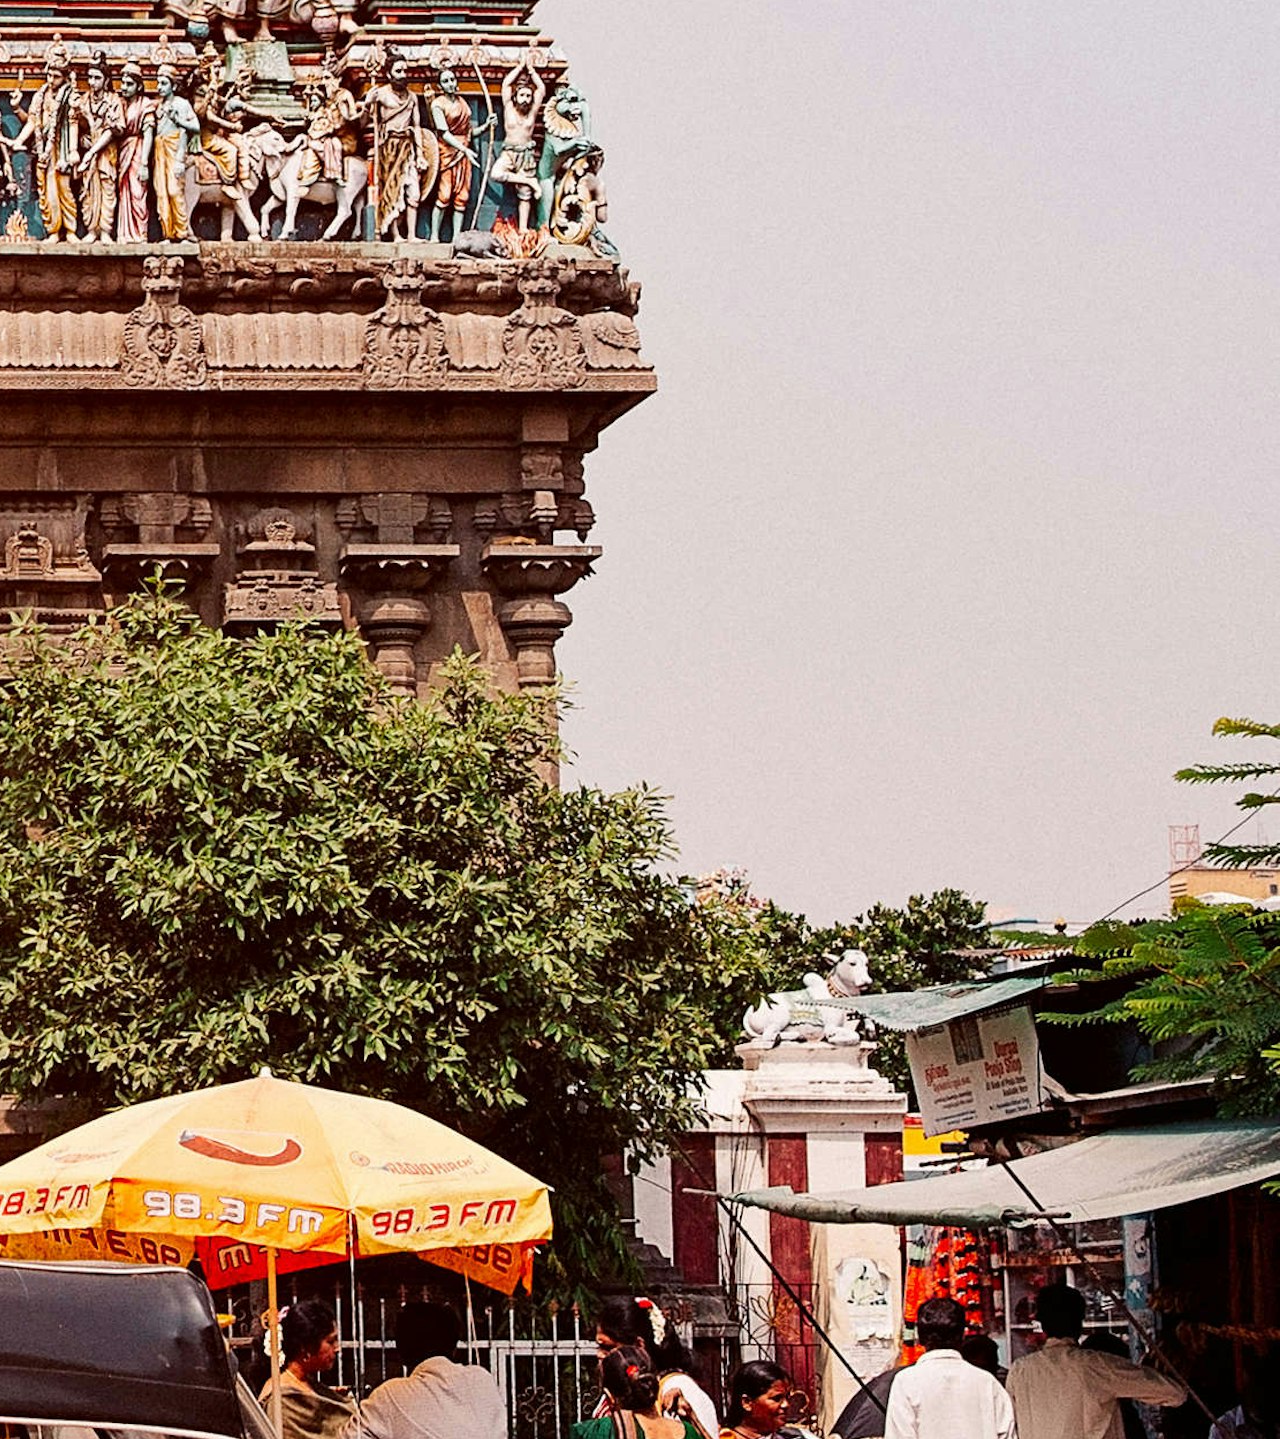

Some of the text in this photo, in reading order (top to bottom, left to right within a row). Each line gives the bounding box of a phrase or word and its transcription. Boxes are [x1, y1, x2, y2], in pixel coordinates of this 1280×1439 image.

[53, 1183, 92, 1213] FM
[142, 1189, 325, 1235] 98.3 FM
[371, 1198, 518, 1237] 98.3 FM
